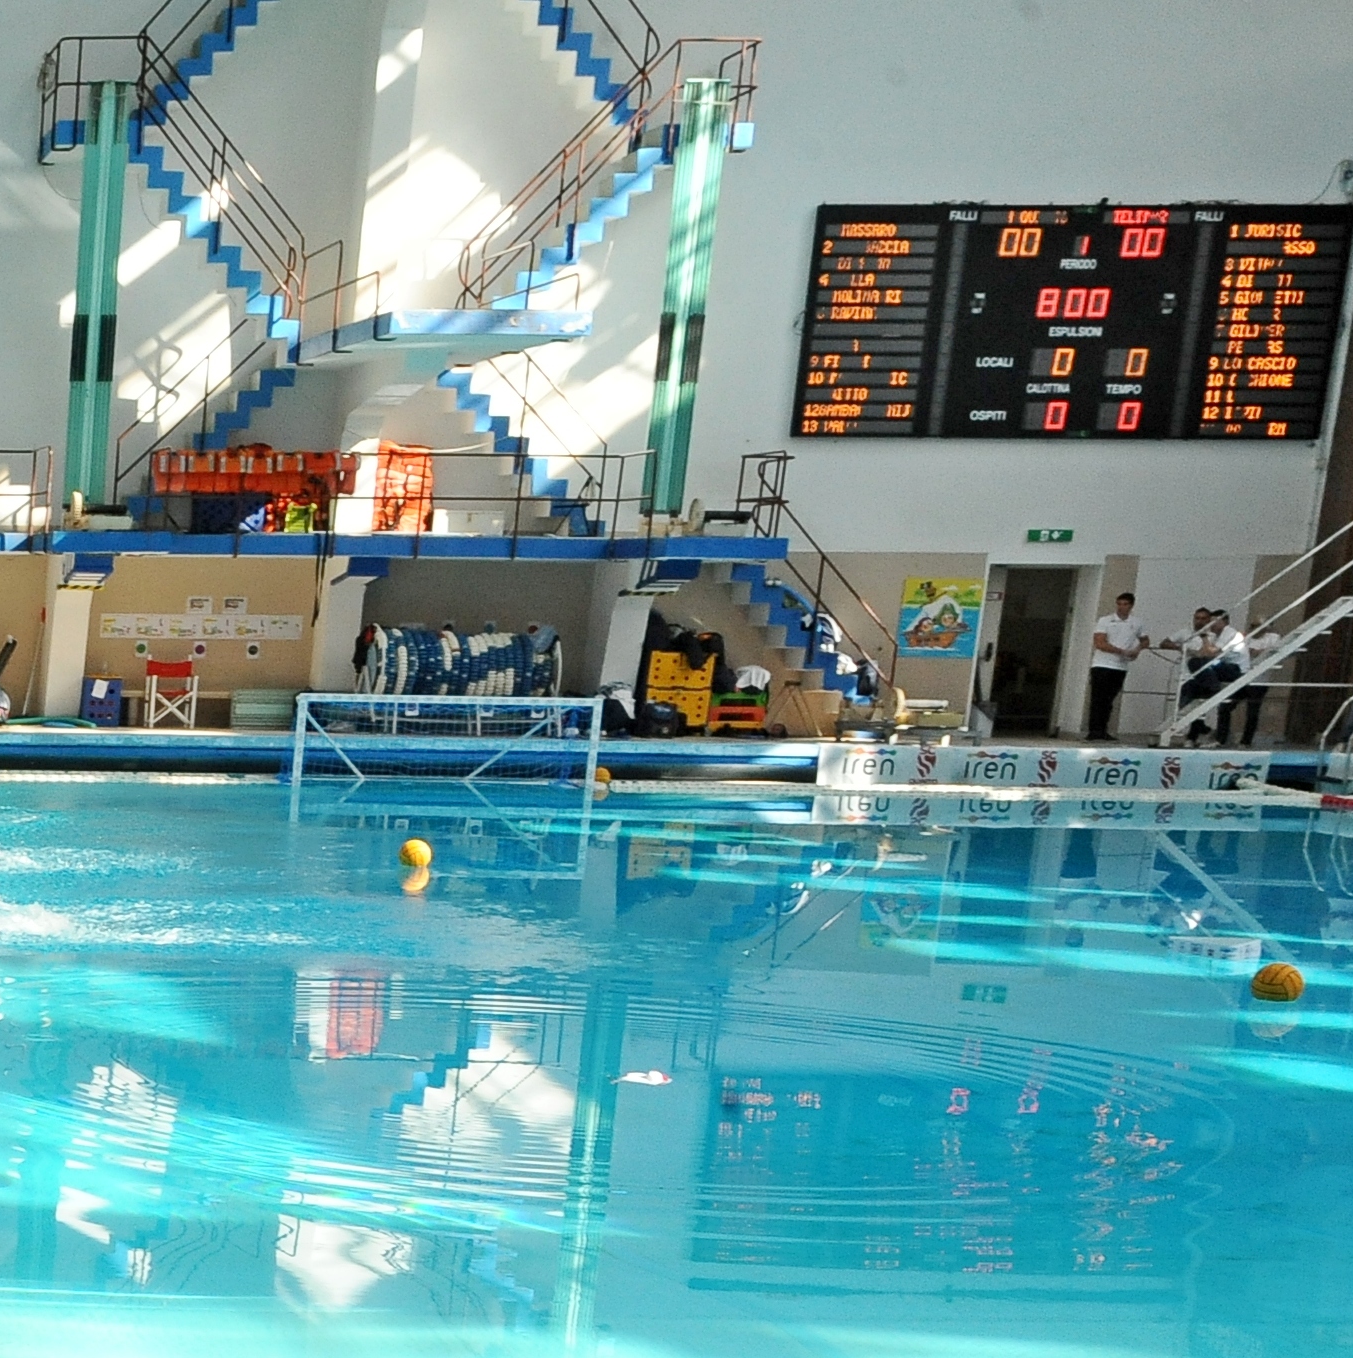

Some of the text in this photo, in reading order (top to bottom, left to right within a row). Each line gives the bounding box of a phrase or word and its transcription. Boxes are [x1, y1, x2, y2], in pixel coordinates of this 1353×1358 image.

[949, 211, 978, 221] FALLI
[1194, 212, 1224, 222] FALLI
[1079, 235, 1090, 256] 1
[1059, 259, 1097, 270] PERIODO
[1048, 327, 1103, 337] ESPULSIONI
[975, 357, 1014, 367] LOCALI
[1026, 383, 1070, 394] CALOTTINA
[1106, 384, 1142, 395] TEMPO
[969, 410, 1007, 421] OSPITI
[842, 757, 895, 776] iren
[963, 760, 1016, 780] iren
[1084, 764, 1138, 787] iren
